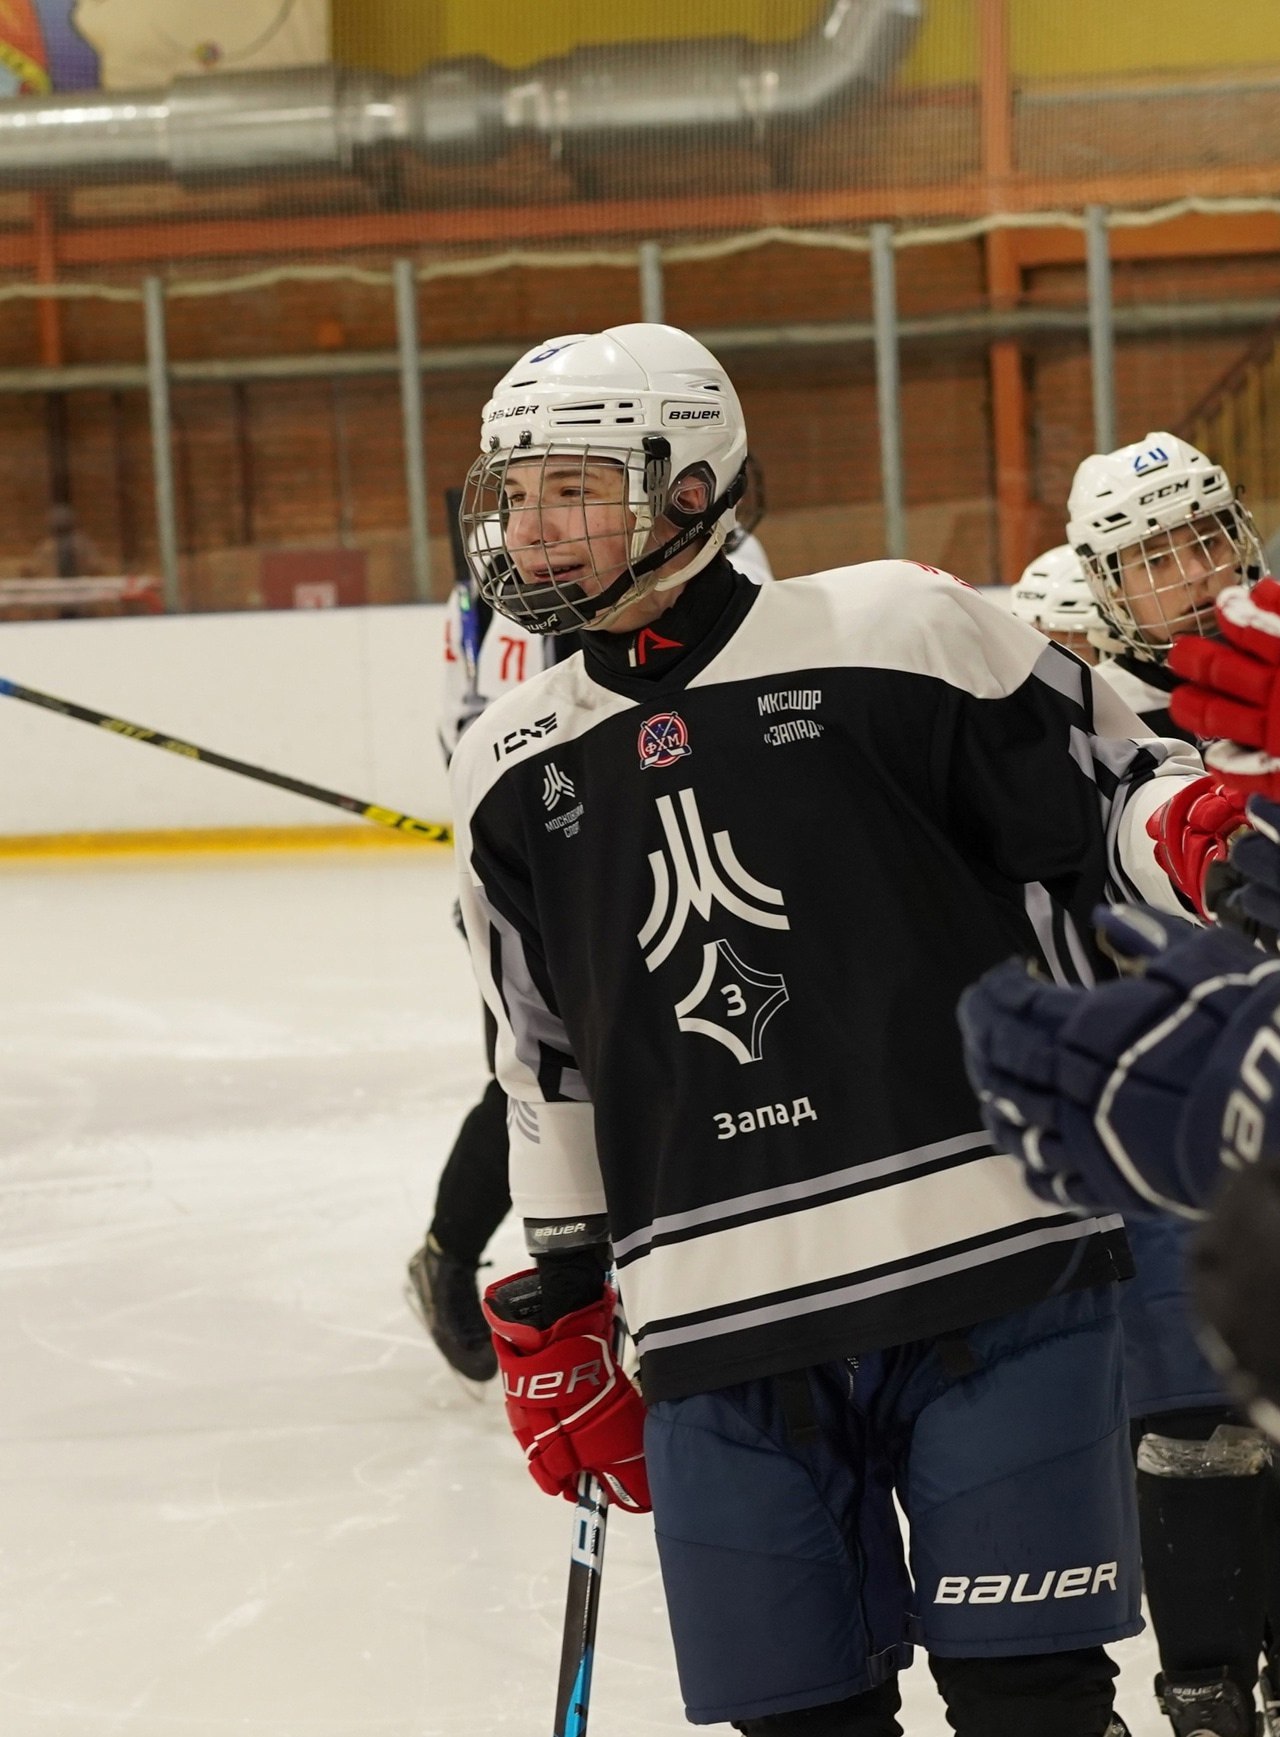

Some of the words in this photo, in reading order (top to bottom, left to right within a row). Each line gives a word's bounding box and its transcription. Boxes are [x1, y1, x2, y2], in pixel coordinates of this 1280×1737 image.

[668, 410, 721, 420] BAUER
[1139, 479, 1190, 506] CCM
[498, 636, 527, 682] 71
[757, 689, 822, 716] МКСШОР
[645, 732, 681, 755] ФХМ
[720, 983, 747, 1017] 3
[713, 1096, 818, 1140] Запад
[534, 1221, 587, 1238] BAUER
[501, 1360, 602, 1400] UER
[932, 1560, 1118, 1605] BAUER
